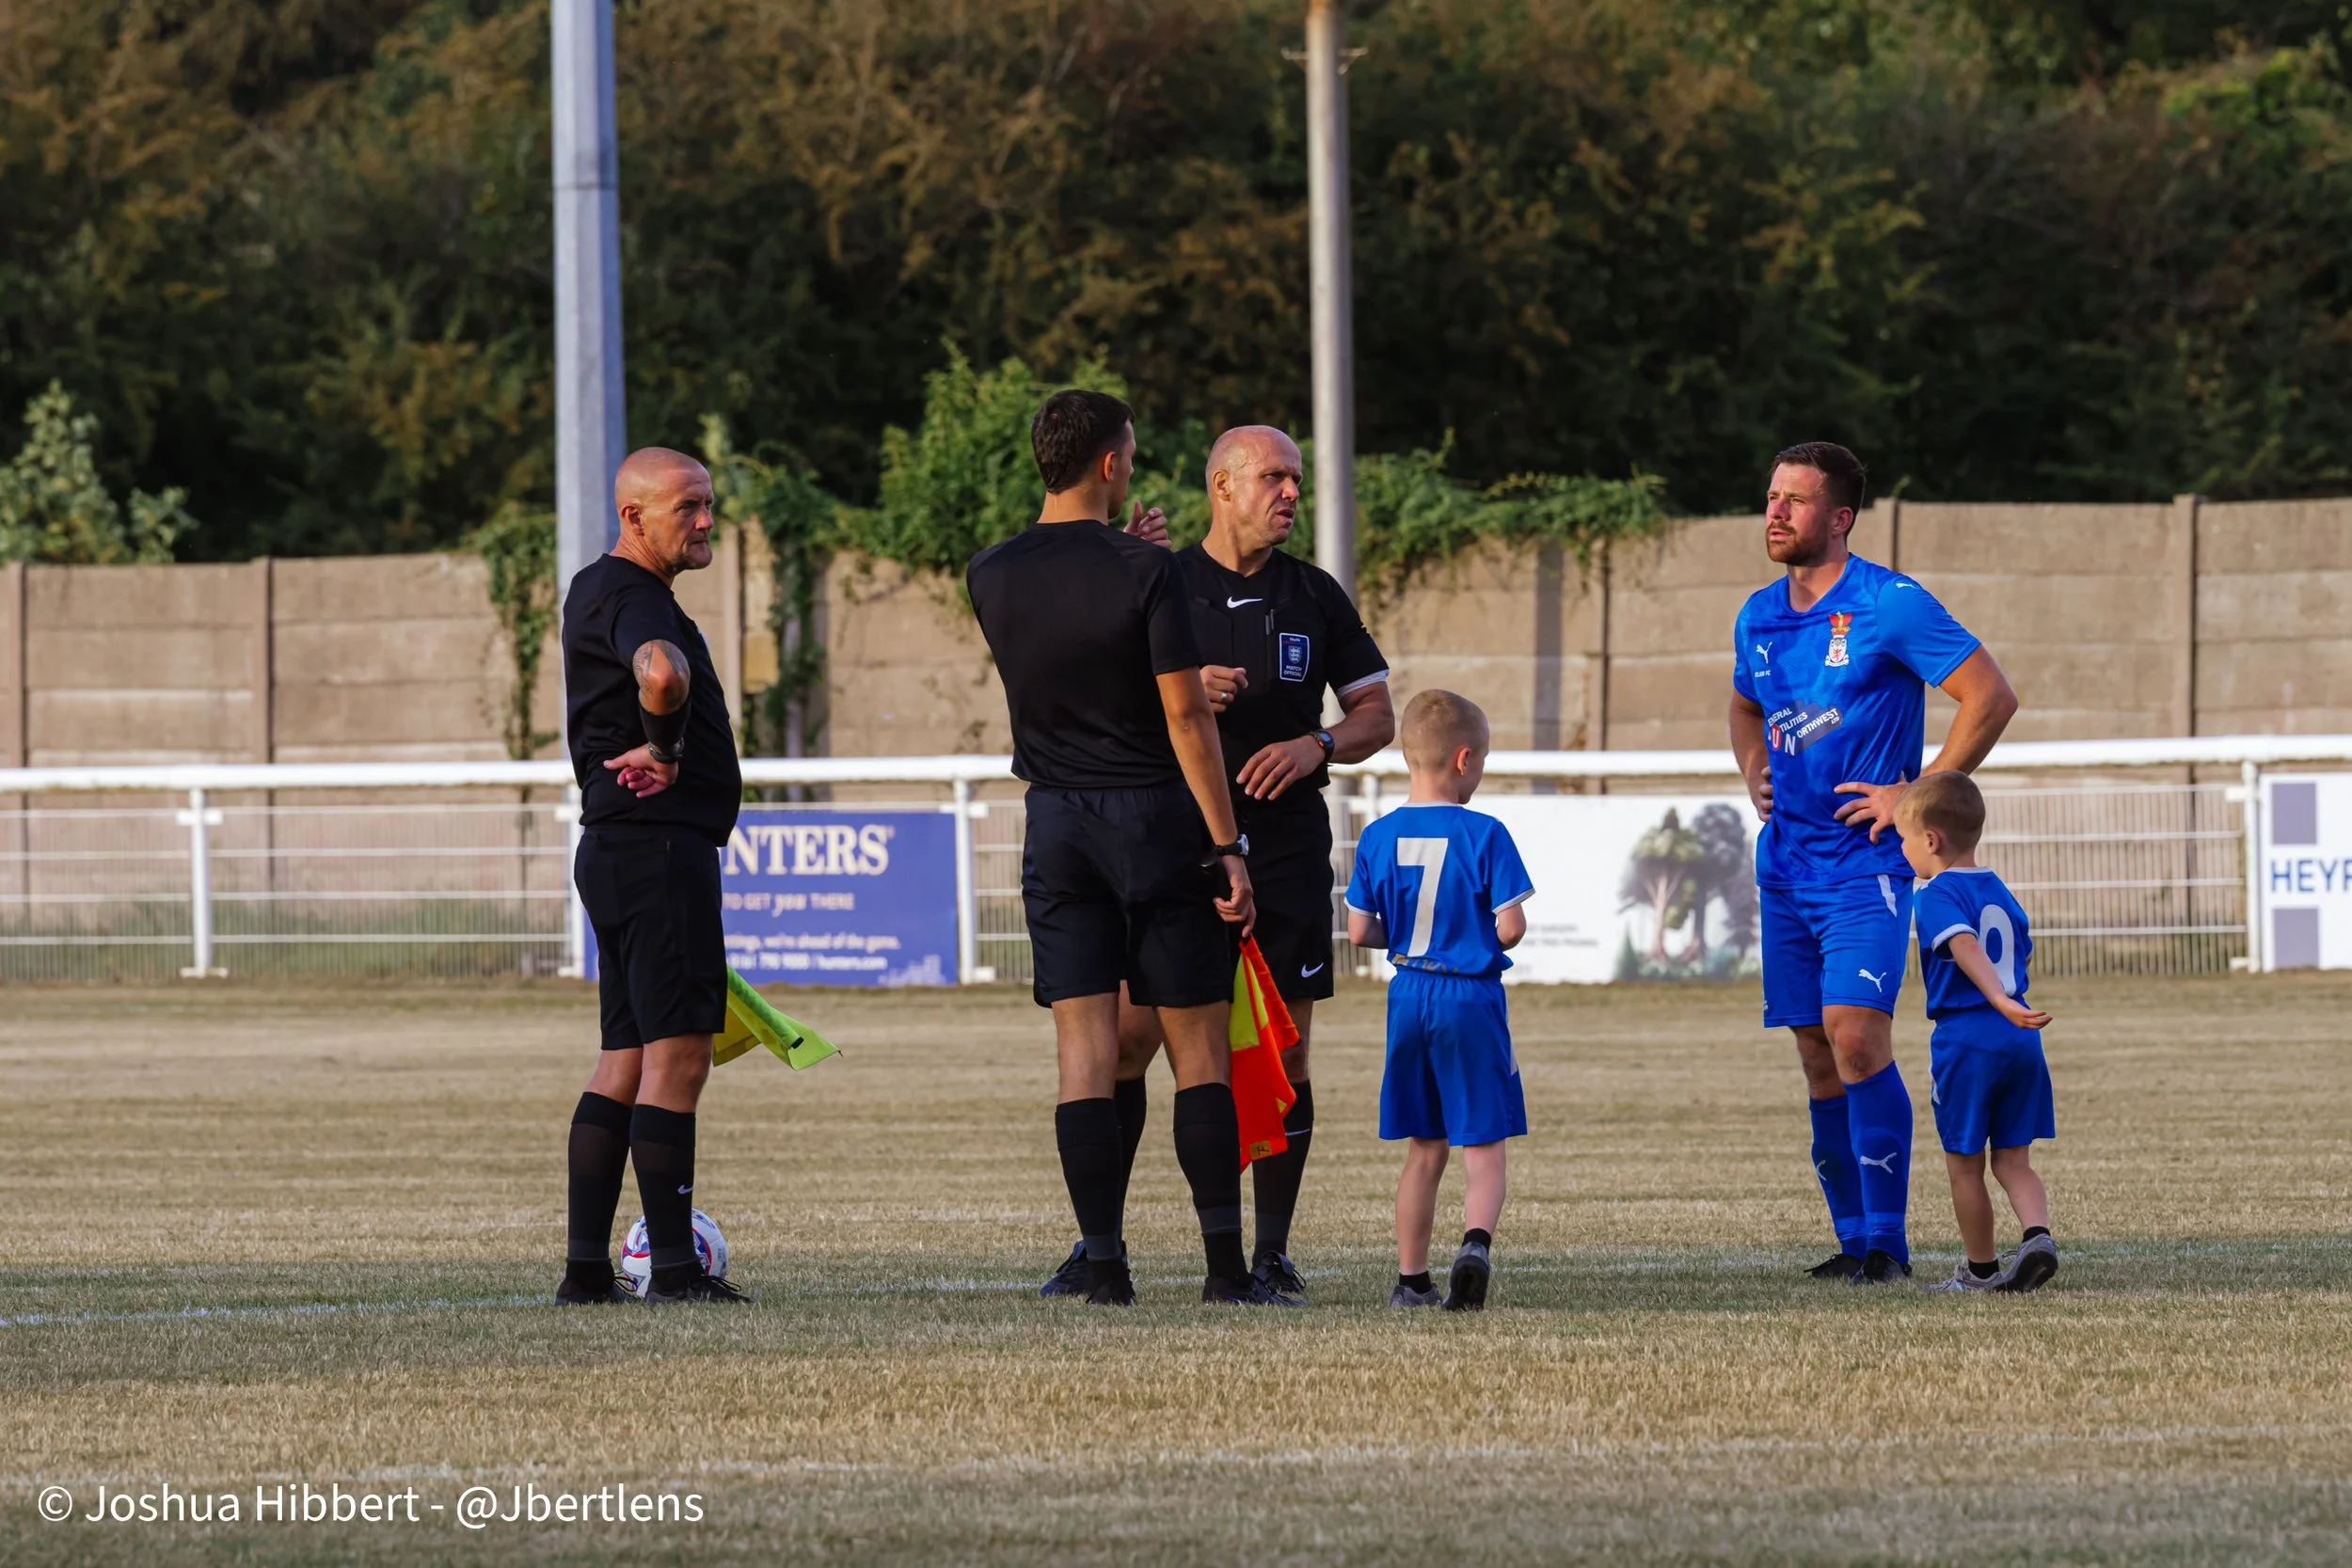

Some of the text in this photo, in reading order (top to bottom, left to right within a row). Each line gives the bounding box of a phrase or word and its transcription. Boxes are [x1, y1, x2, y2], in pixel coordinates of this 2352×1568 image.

[771, 893, 807, 917] you
[810, 893, 855, 911] THERE
[1397, 837, 1449, 958] 7
